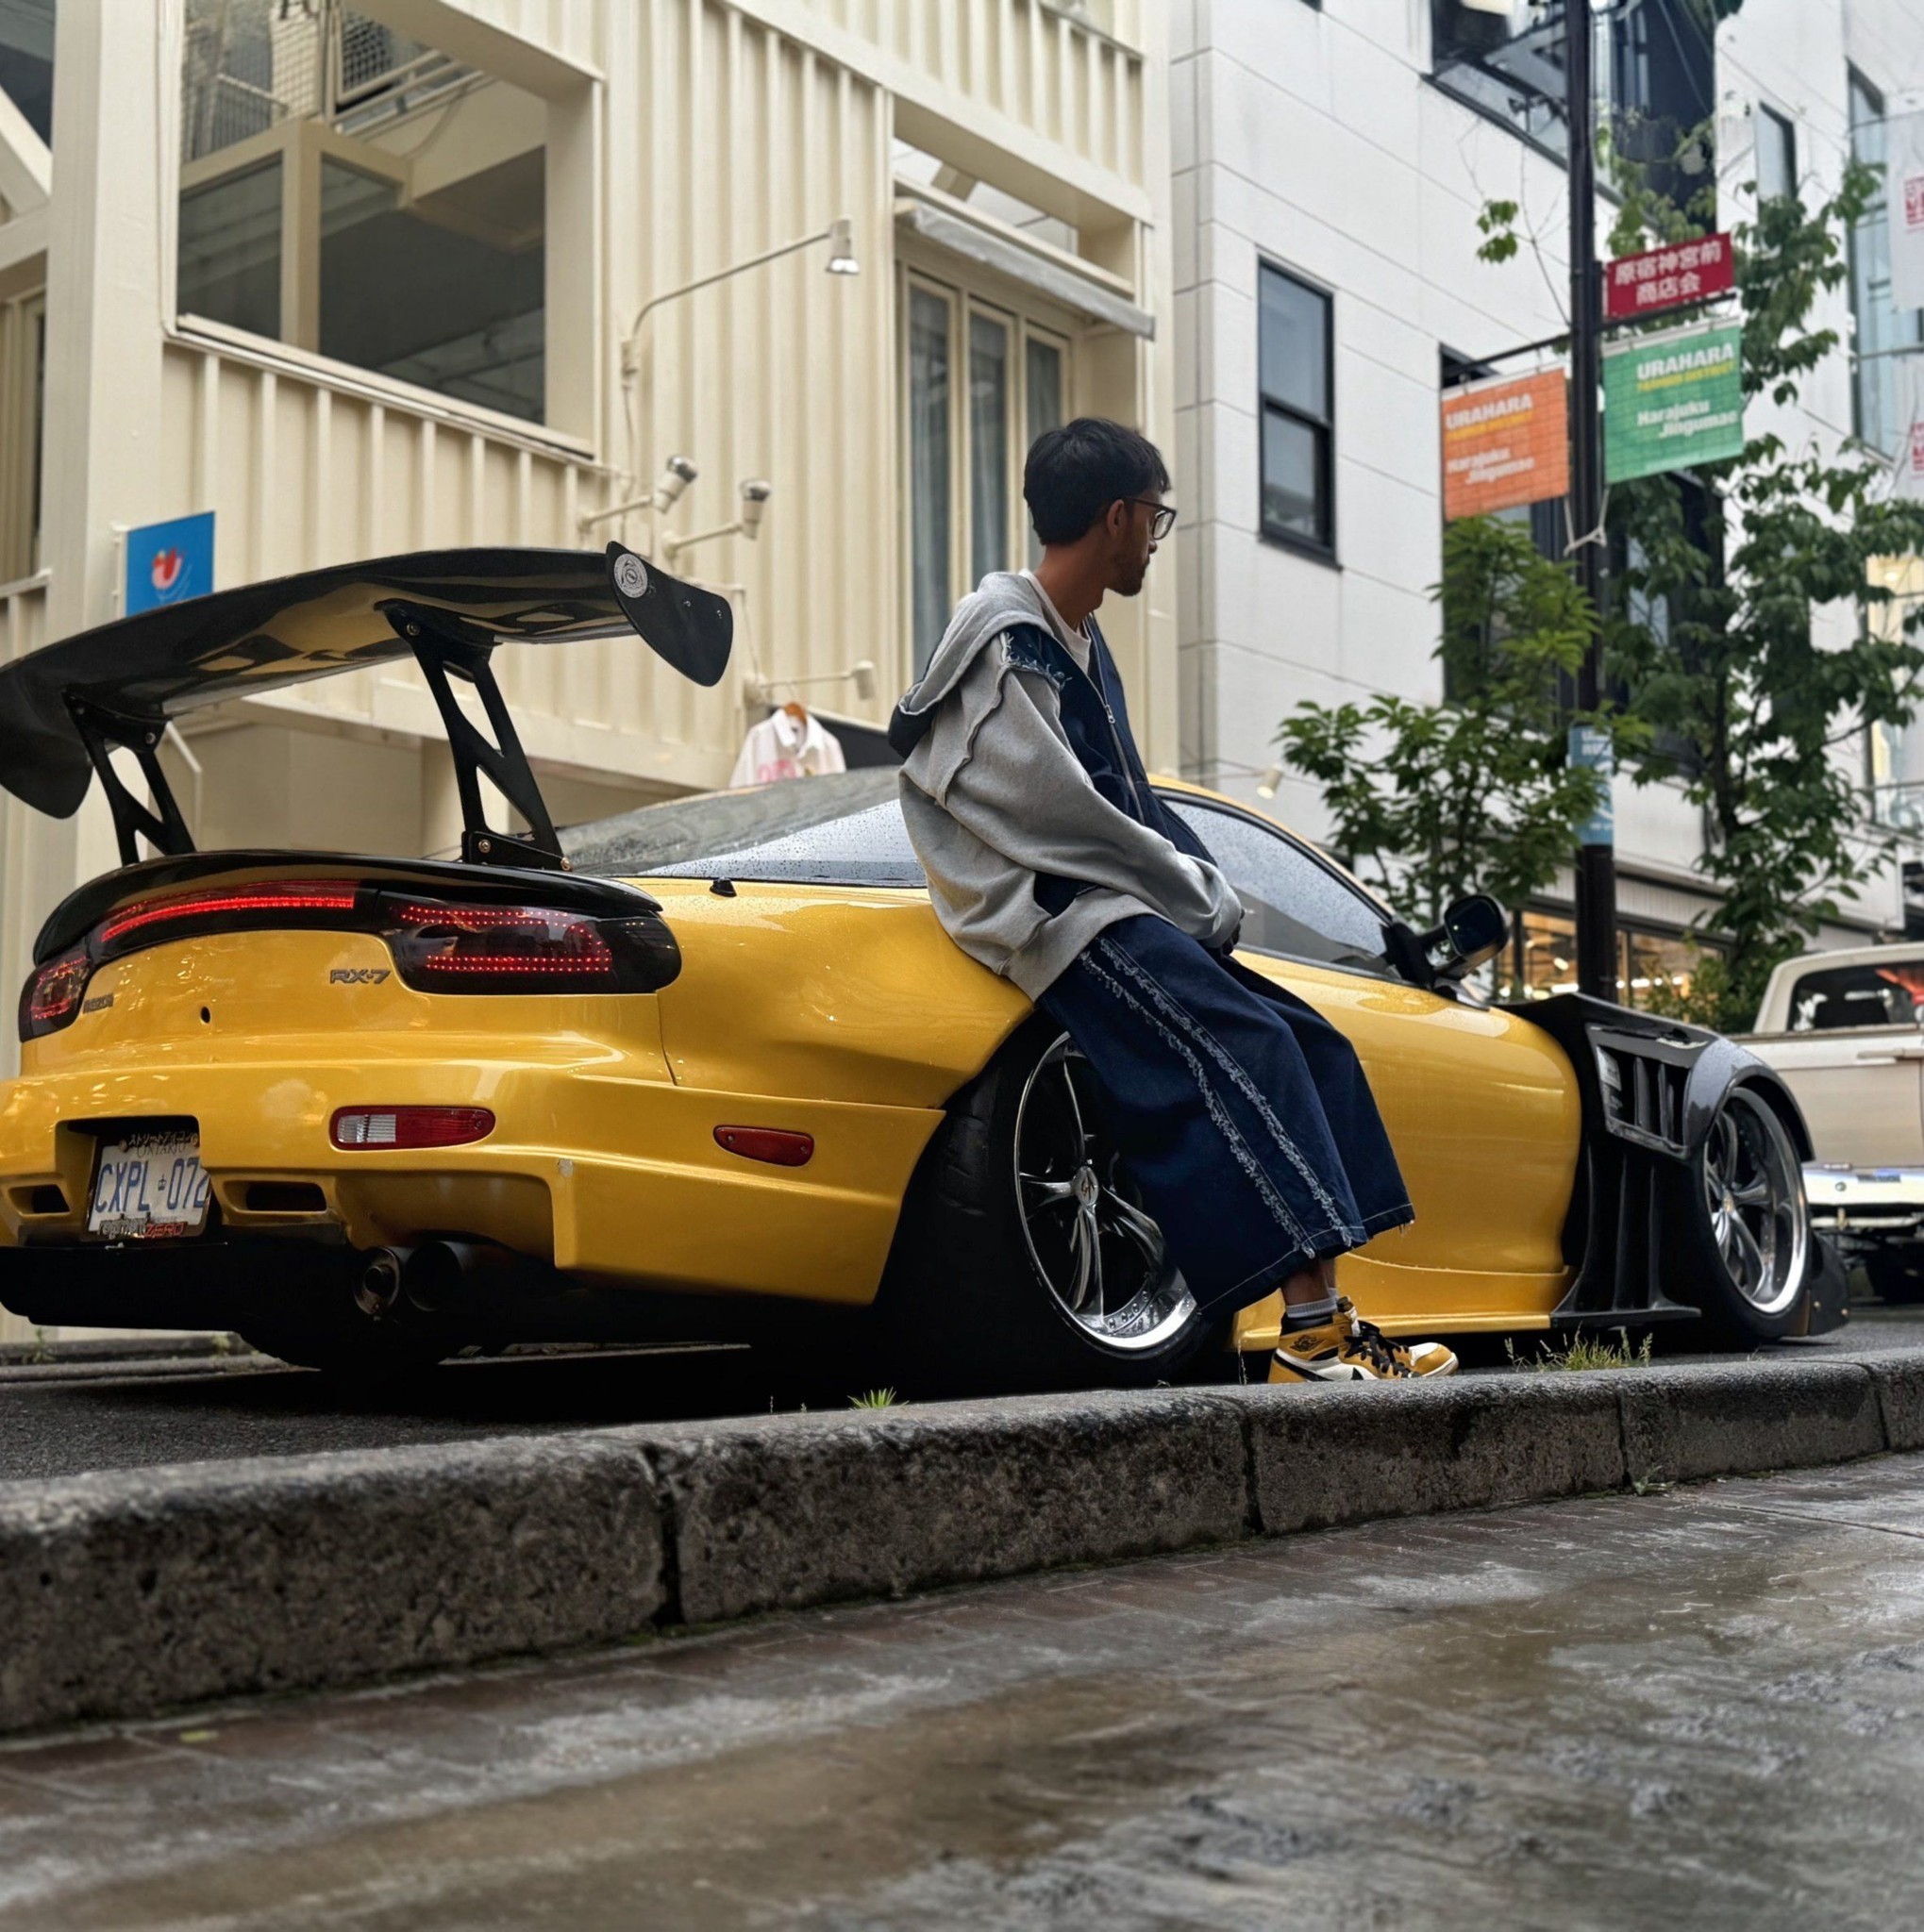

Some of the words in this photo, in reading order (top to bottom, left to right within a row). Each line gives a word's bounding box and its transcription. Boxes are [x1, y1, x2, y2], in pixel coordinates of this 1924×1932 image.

[1615, 240, 1722, 286] 原宿神宮前
[1636, 271, 1701, 307] 商店会
[1637, 341, 1734, 381] URAHARA
[1446, 392, 1533, 430] URAHARA
[1637, 400, 1710, 427] Harajuku
[330, 969, 391, 984] RX-7
[94, 1160, 151, 1213] CXPL
